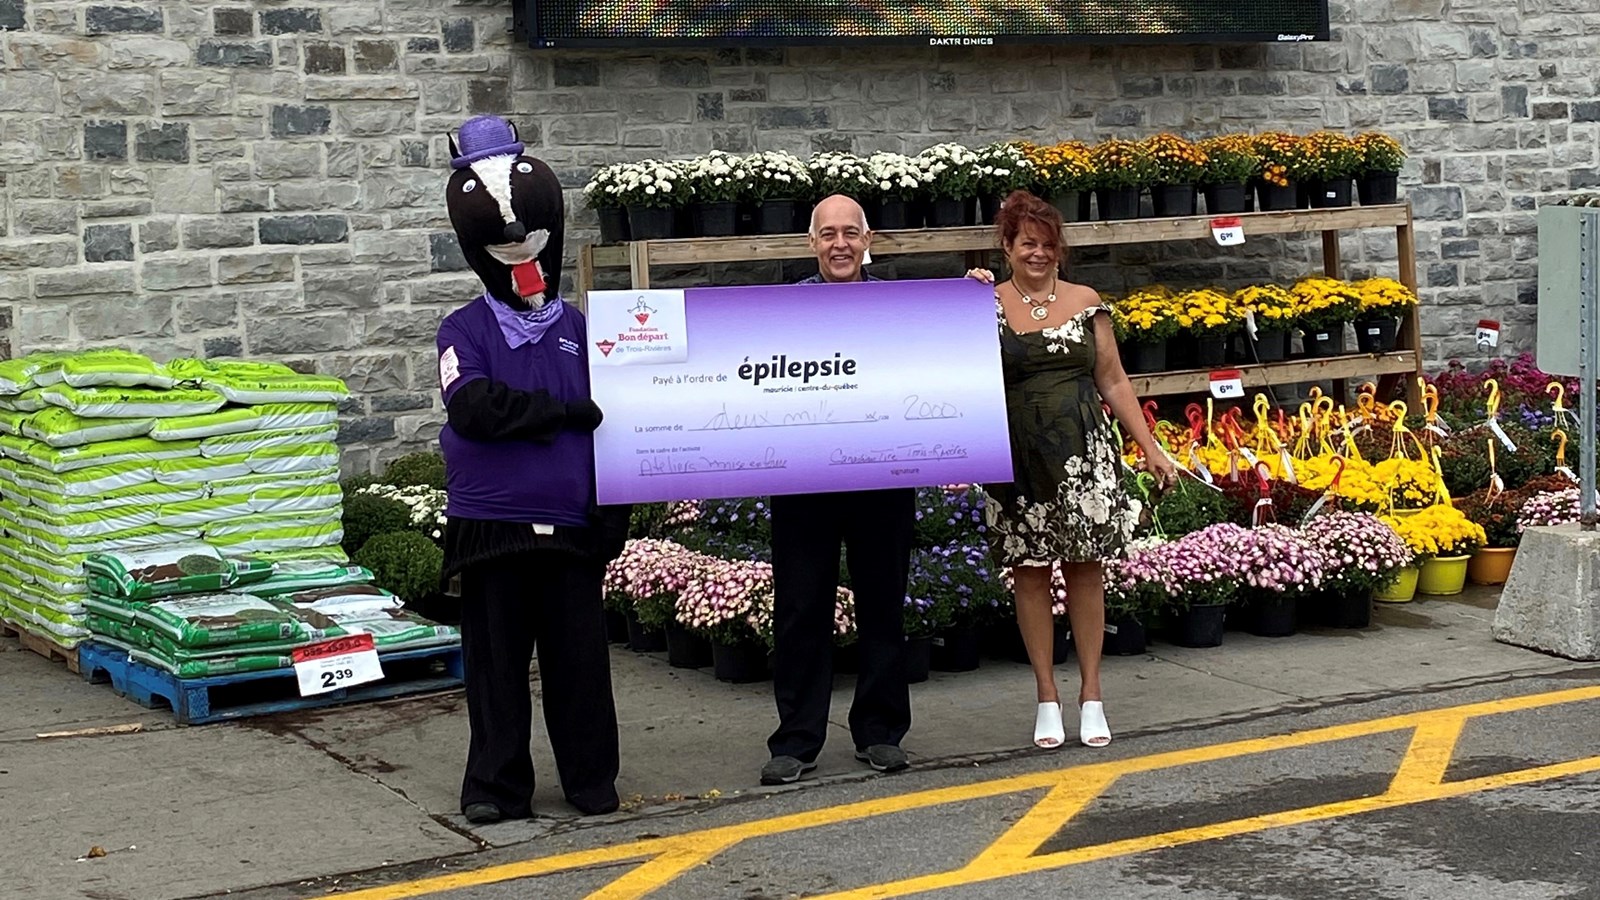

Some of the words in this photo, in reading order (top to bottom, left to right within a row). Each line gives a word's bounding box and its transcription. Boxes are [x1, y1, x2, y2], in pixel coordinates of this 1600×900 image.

[617, 333, 636, 342] Bon
[636, 332, 669, 343] départ
[738, 352, 857, 386] épilepsie
[652, 375, 674, 387] Payé
[676, 374, 682, 384] à
[683, 373, 714, 384] l'ordre
[715, 373, 728, 383] de
[762, 385, 794, 394] mauricie
[797, 382, 859, 393] centre-du-québec
[634, 425, 643, 433] La
[645, 424, 672, 433] somme
[673, 423, 684, 432] de
[889, 467, 920, 476] signature
